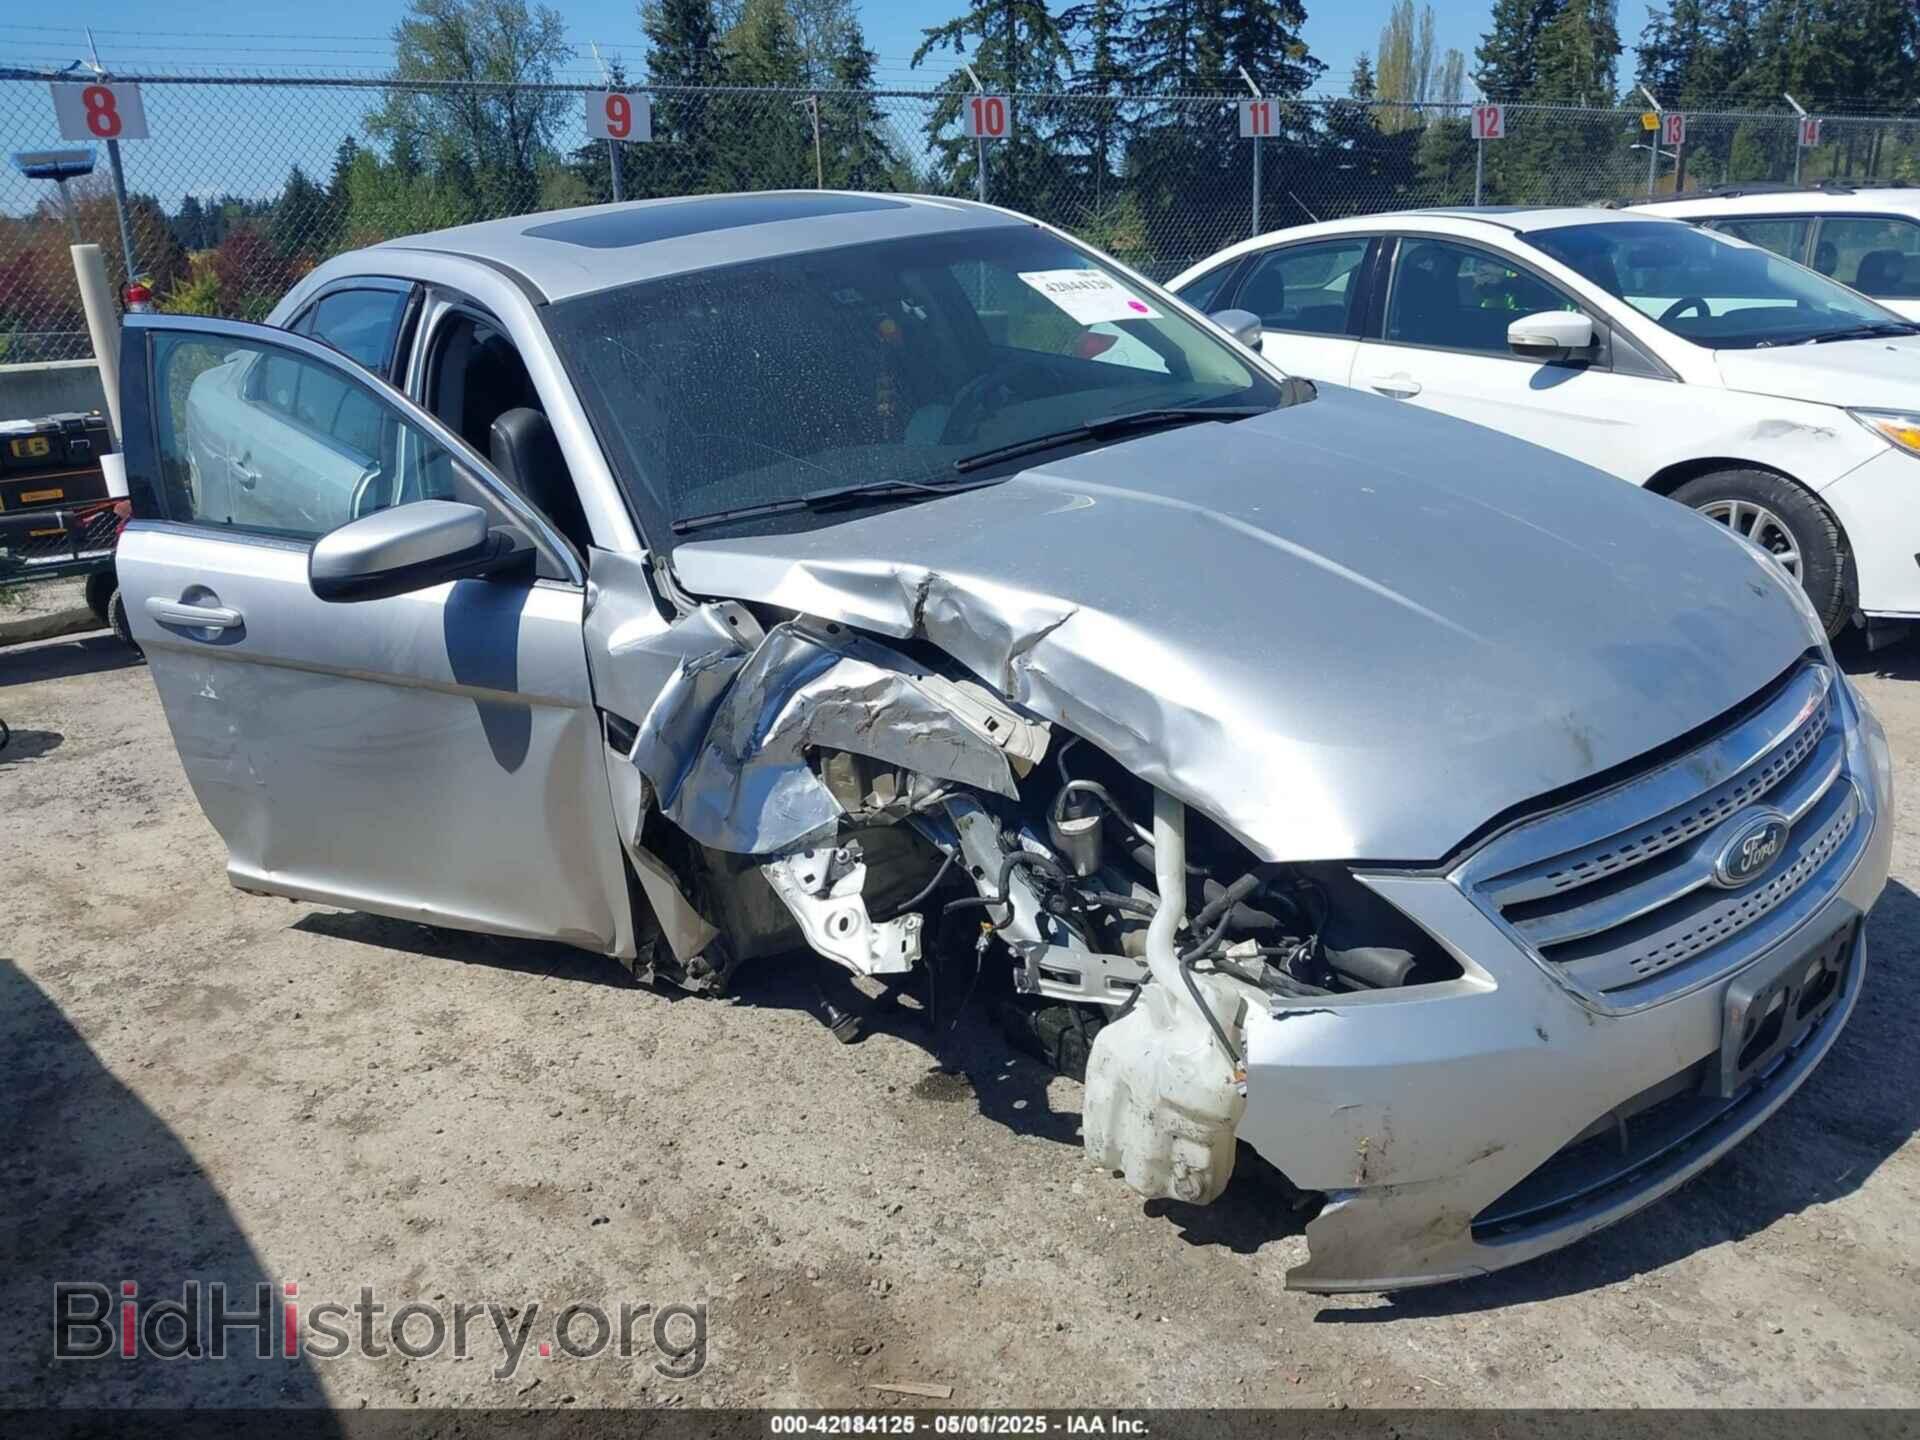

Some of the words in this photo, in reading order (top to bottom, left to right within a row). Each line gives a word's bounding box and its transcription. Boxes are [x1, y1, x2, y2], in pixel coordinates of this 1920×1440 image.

[82, 86, 121, 137] 8
[605, 94, 631, 137] 9
[971, 97, 1005, 136] 10
[1250, 102, 1269, 135] 11
[1478, 107, 1498, 137] 12
[1667, 115, 1682, 143] 13
[1803, 120, 1816, 145] 14
[1741, 829, 1777, 872] Ford
